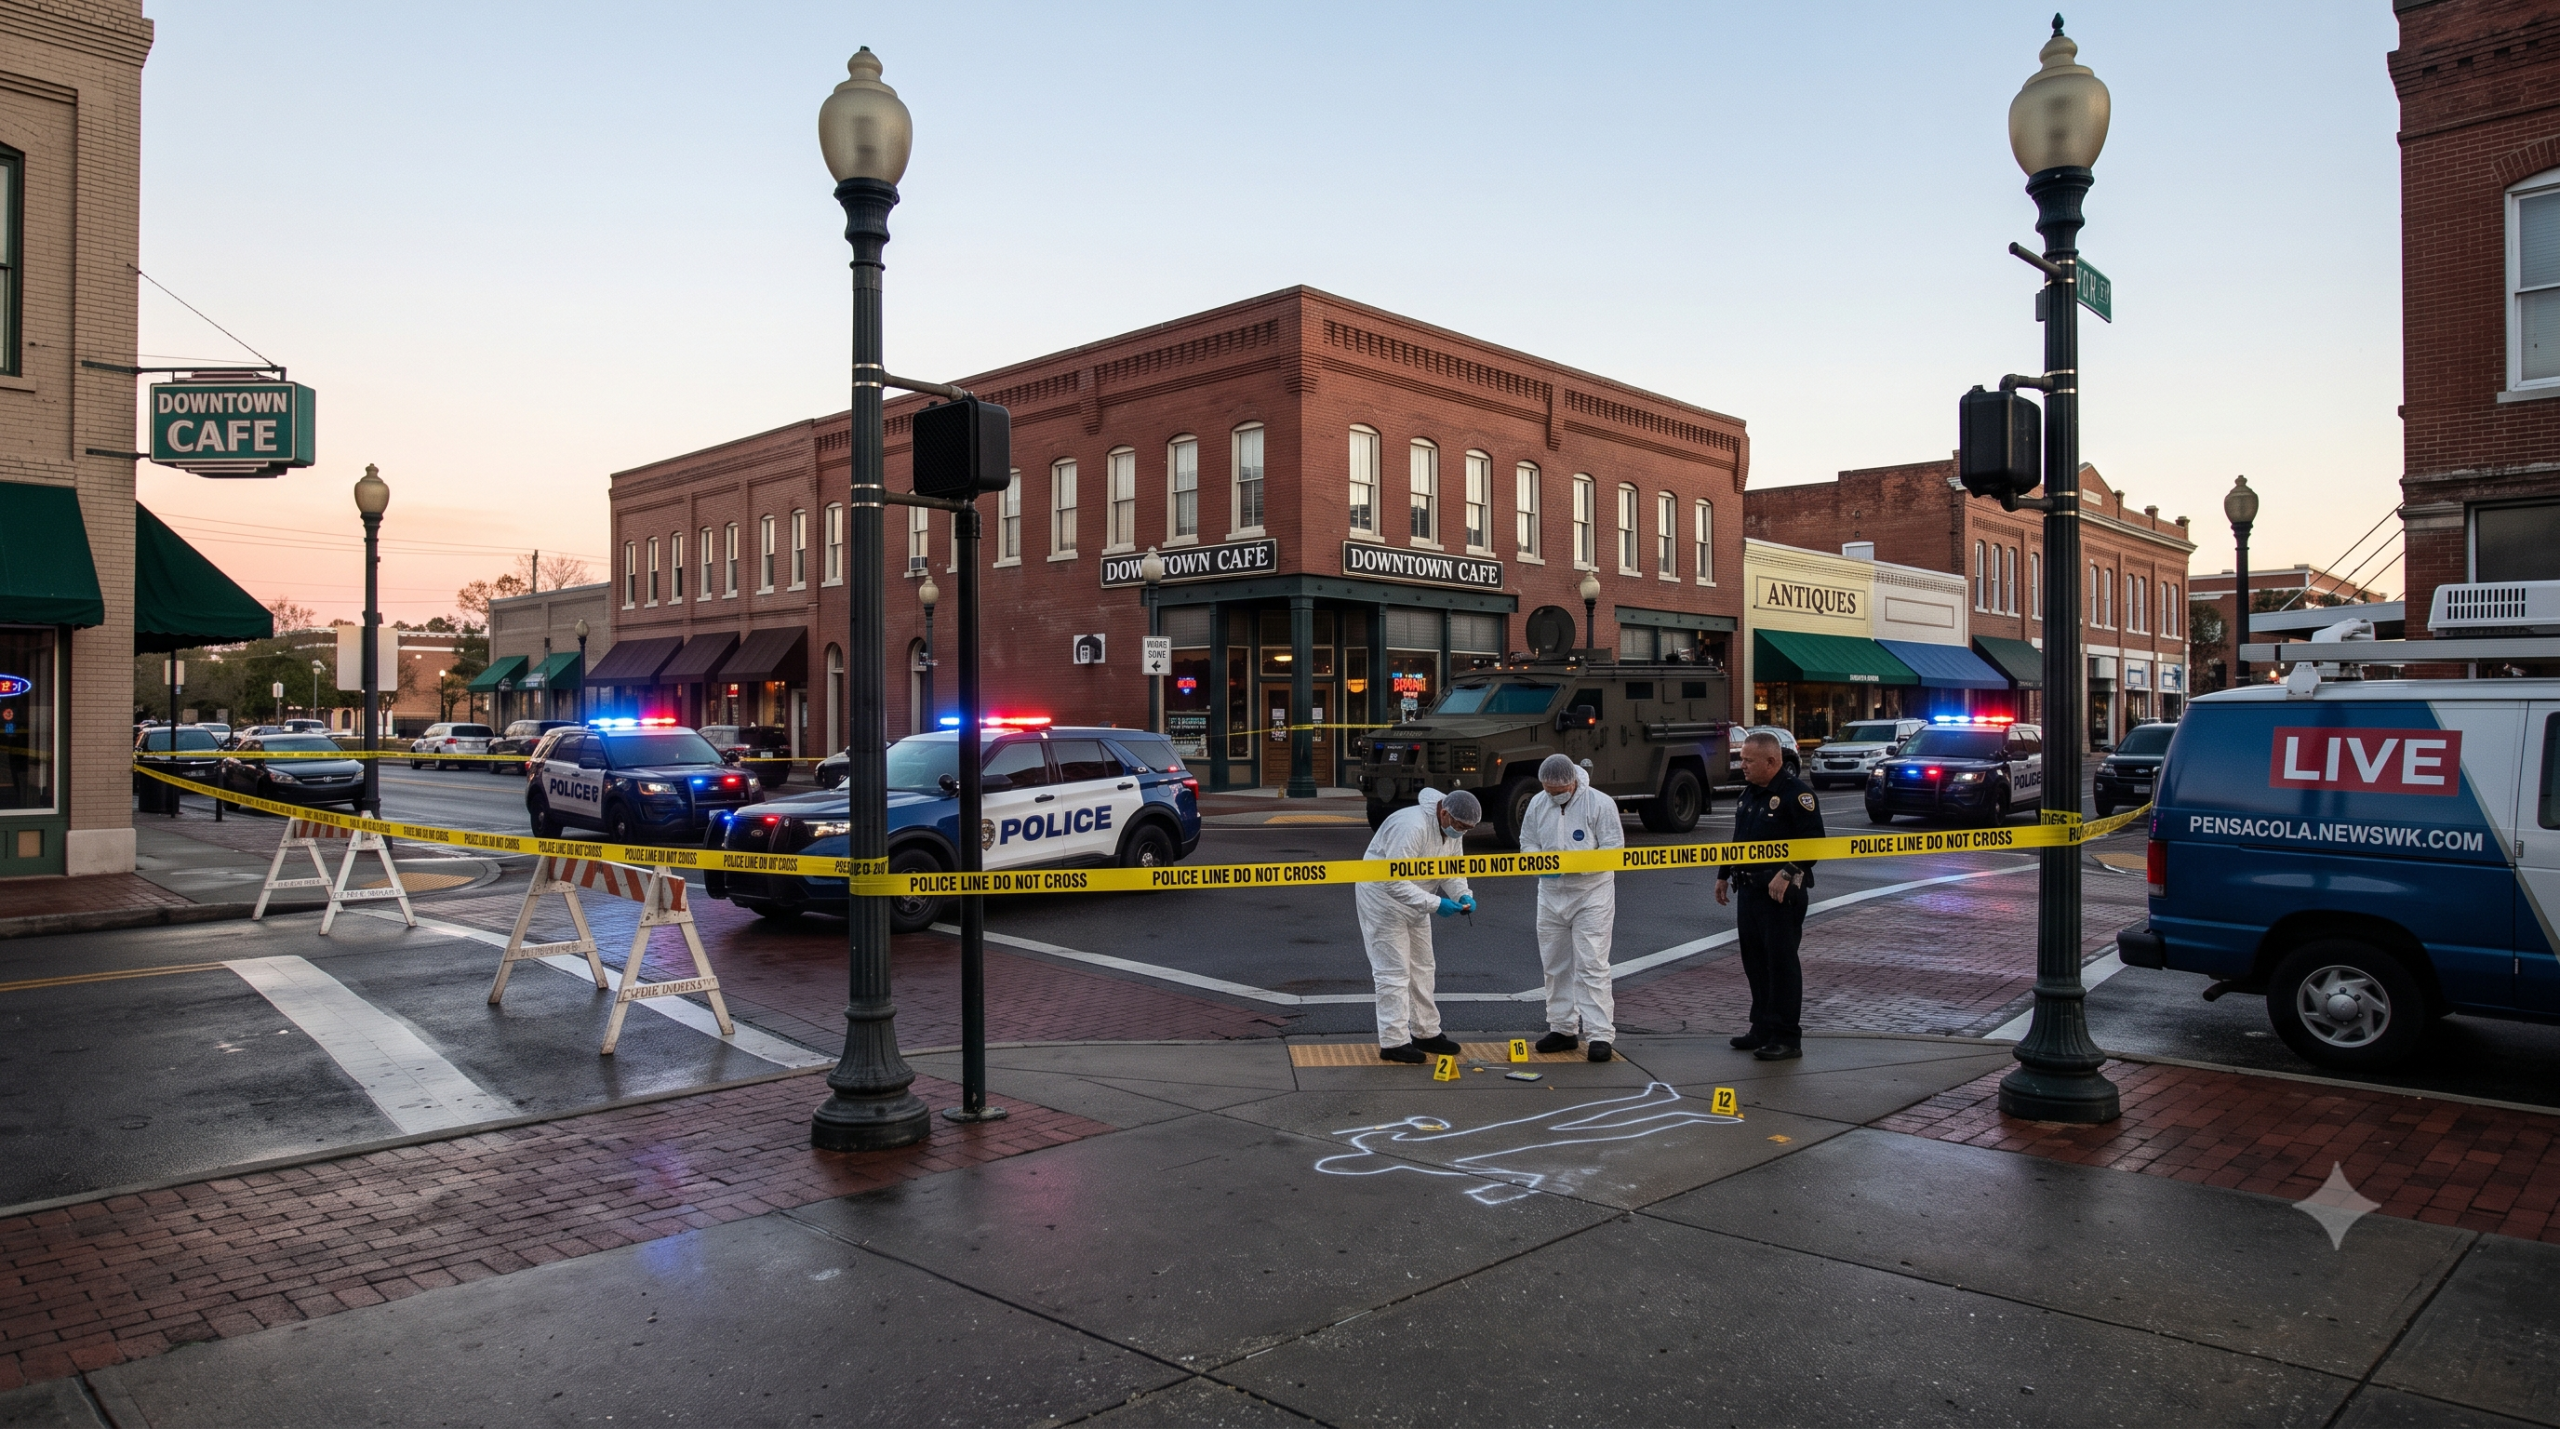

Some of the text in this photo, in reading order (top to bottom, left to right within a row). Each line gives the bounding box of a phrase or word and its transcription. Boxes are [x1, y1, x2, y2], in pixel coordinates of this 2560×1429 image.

[158, 392, 287, 414] DOWNTOWN
[167, 420, 278, 452] CAFE
[1106, 552, 1211, 581] DOWTOWN
[1350, 548, 1498, 584] DOWNTOWN CAFE
[1767, 582, 1856, 614] ANTIQUES
[2284, 736, 2447, 785] LIVE
[1000, 805, 1112, 846] POLICE
[2190, 816, 2483, 852] PENSACOLA.NEWSWK.COM
[1850, 830, 2012, 854] POLICE LINE DO NOT CROSS
[1390, 855, 1560, 877] POLICE LINE DO NOT CROSS
[1623, 843, 1789, 866] POLICE LINE DO NOT CROSS
[910, 872, 1087, 892] POLICE LINE DO NOT CROSS
[1153, 865, 1326, 886] POLICE LINE DO NOT CROSS
[1438, 1058, 1448, 1074] 2
[1718, 1091, 1732, 1107] 12
